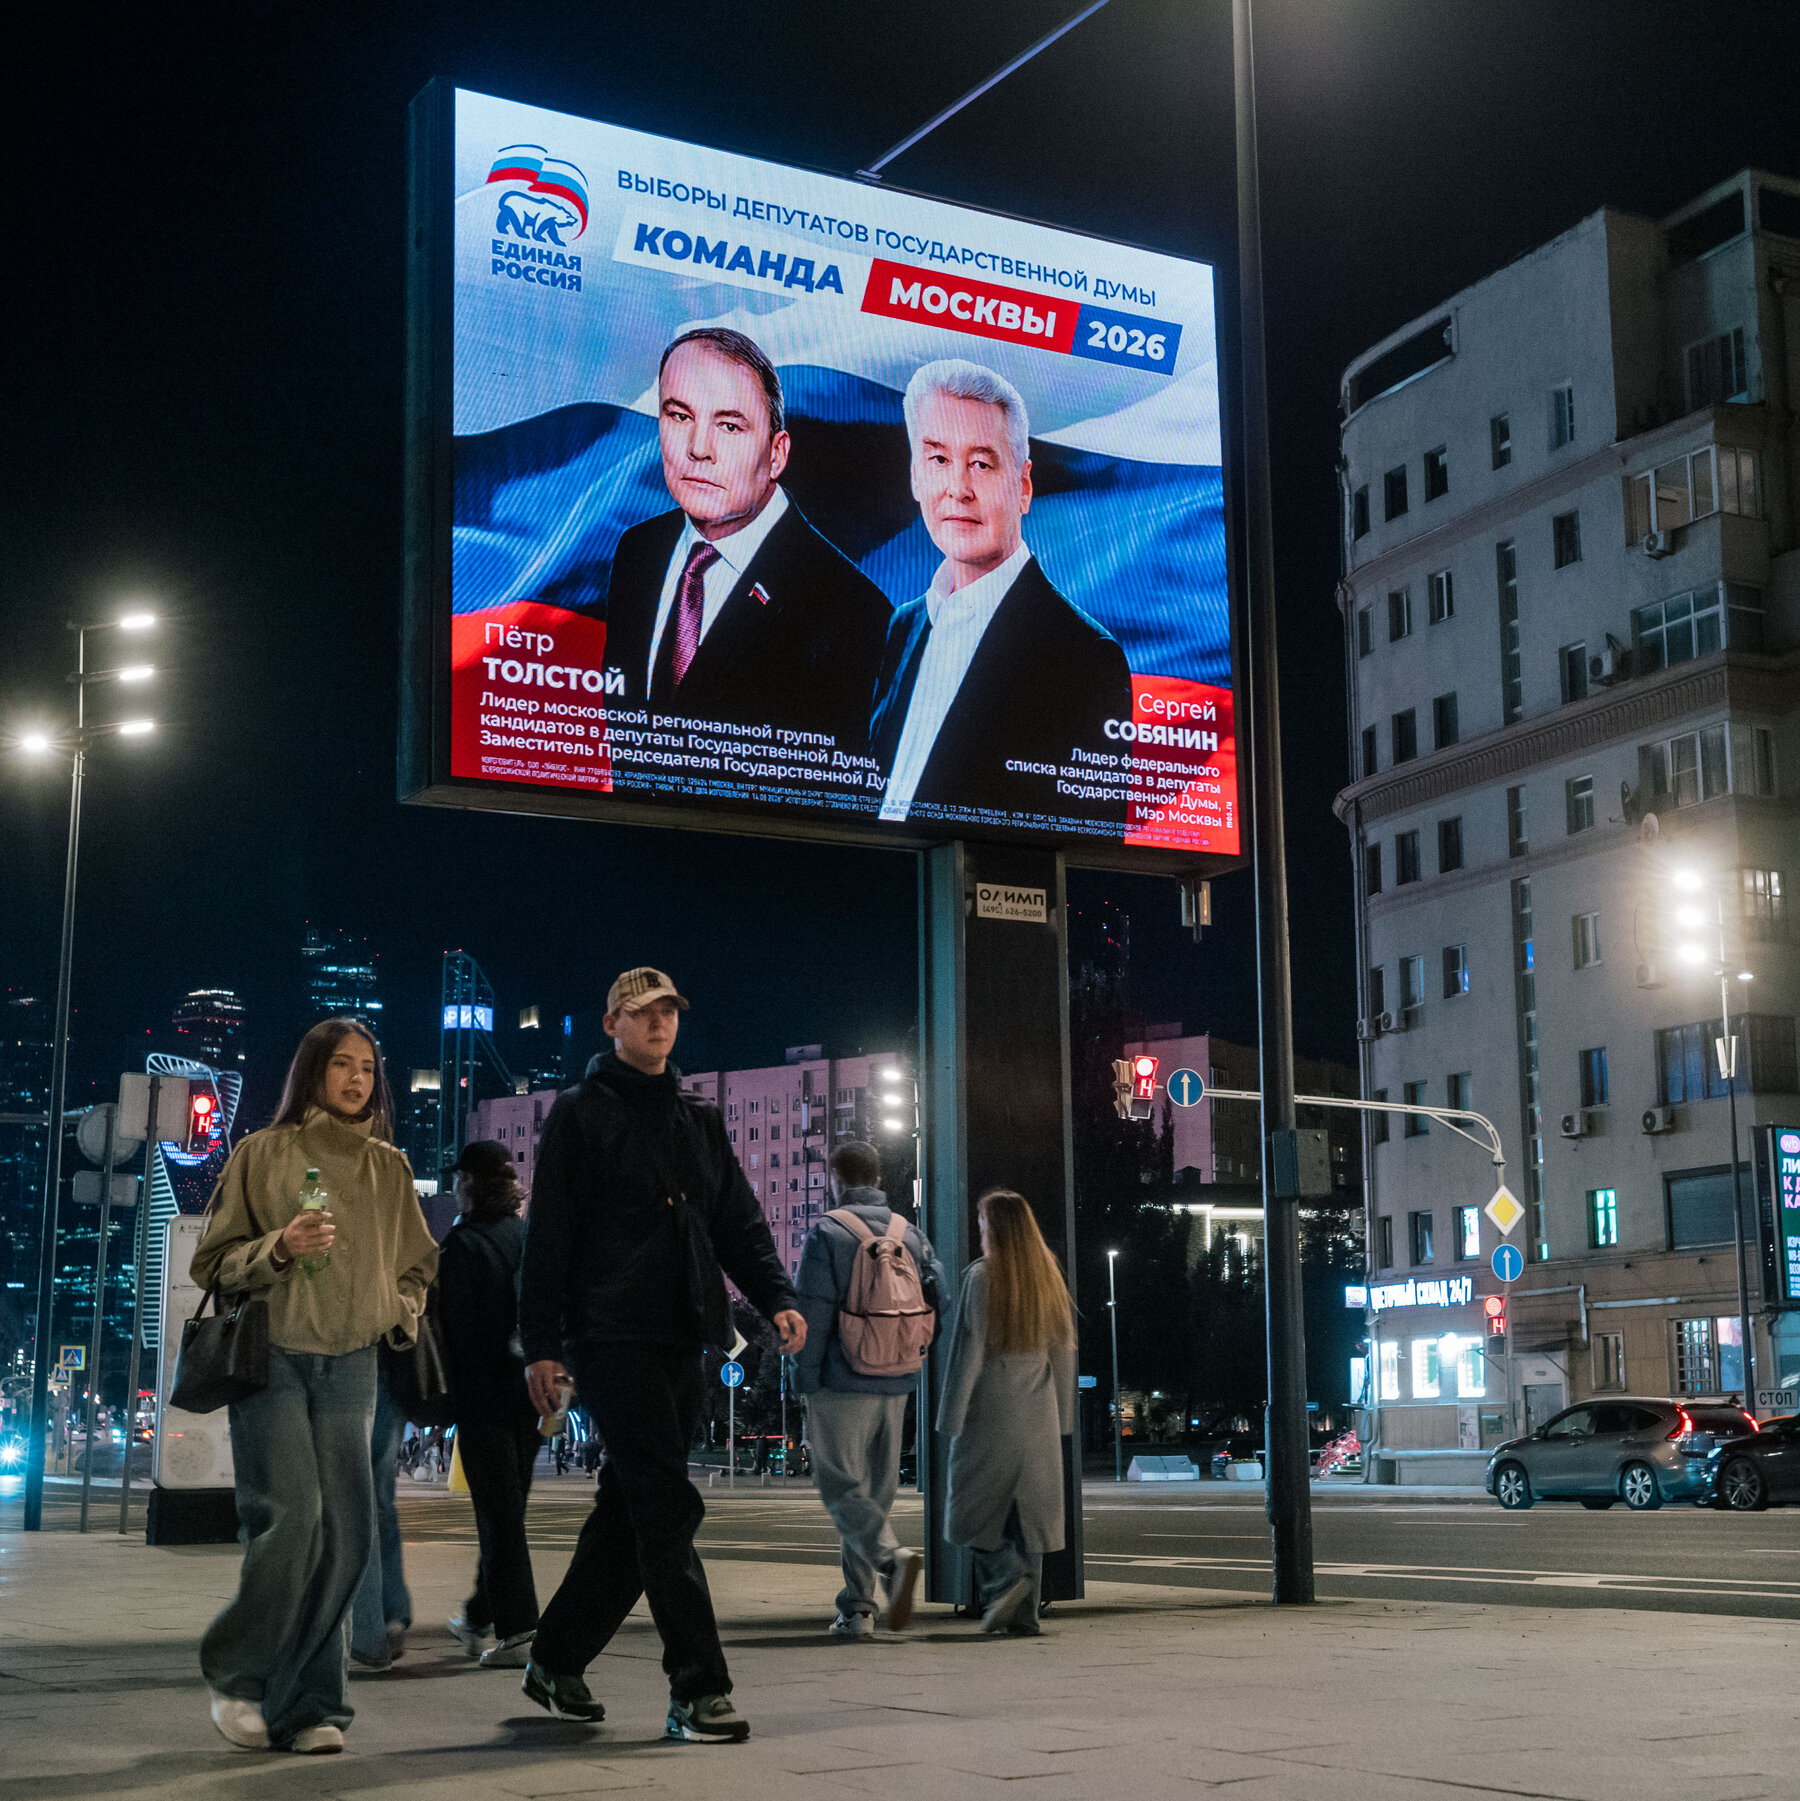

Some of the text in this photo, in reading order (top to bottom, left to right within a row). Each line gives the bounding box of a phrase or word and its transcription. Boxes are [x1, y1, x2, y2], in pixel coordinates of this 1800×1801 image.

[617, 169, 1156, 307] ВЫБОРЫ ДЕПУТАТОВ ГОСУДАРСТВЕННОЙ ДУМЫ
[491, 239, 582, 272] ЕДИНАЯ
[491, 258, 582, 292] РОССИЯ
[634, 222, 1166, 361] КОМАНДА МОСКВЫ 2026
[484, 622, 554, 657] Пётр
[482, 656, 625, 696] ТОЛСТОЙ
[480, 692, 836, 747] Лидер московской региональной группы
[1138, 693, 1216, 722] Сергей
[480, 714, 880, 772] кандидатов в депутаты Государственной Думы,
[1104, 719, 1218, 752] СОБЯНИН
[479, 730, 594, 757] Заместитель
[598, 743, 720, 770] Председателя
[724, 757, 862, 787] Государственной
[1071, 748, 1220, 779] Лидер федерального
[1005, 759, 1221, 795] списка кандидатов в депутаты
[1056, 779, 1222, 812] Государственной Думы,
[1135, 805, 1165, 825] Мэр
[1168, 809, 1222, 828] Москвы
[1225, 801, 1233, 828] mos.ru
[1005, 907, 1042, 918] 626-5200
[1417, 1280, 1450, 1308] СКЛАД
[1449, 1276, 1472, 1306] 24/7
[1759, 1392, 1792, 1405] СТОП
